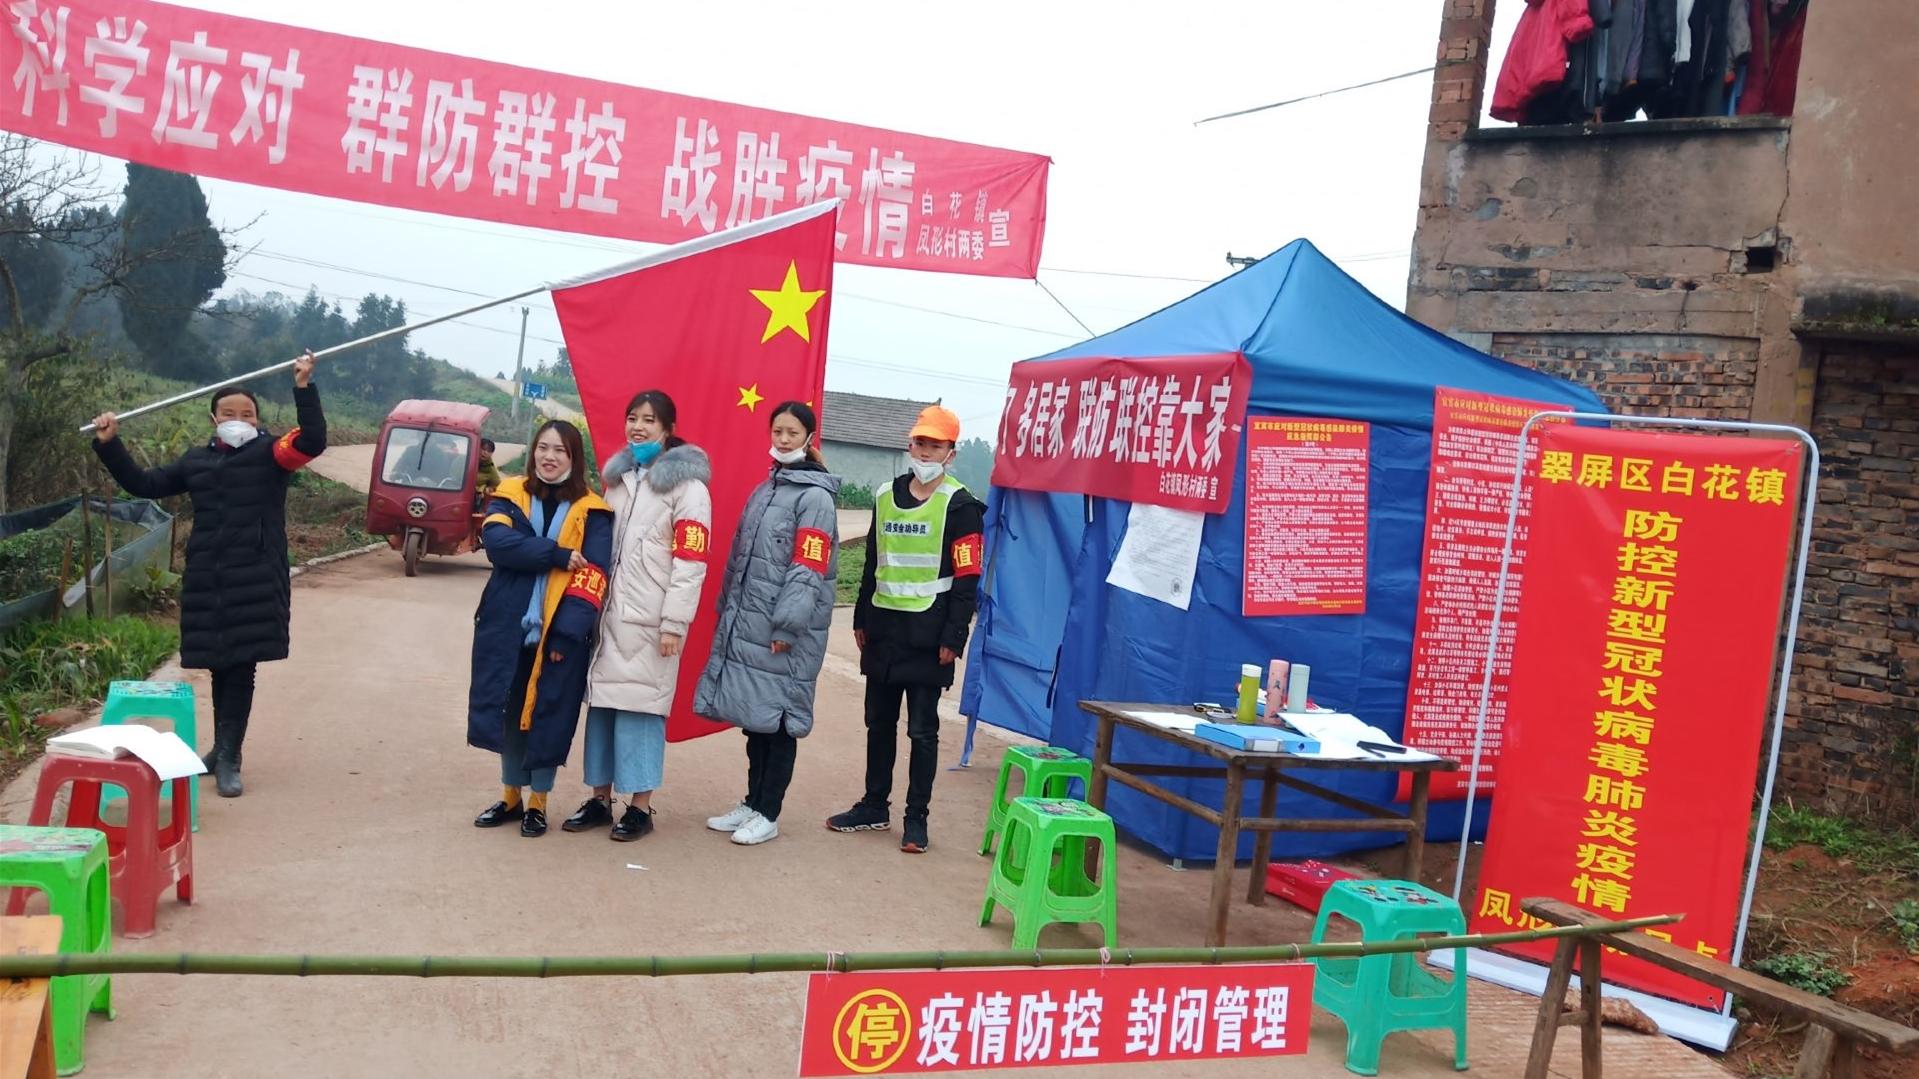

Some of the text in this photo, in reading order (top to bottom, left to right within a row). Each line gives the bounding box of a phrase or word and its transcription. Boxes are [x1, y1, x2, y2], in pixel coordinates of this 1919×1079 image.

[8, 0, 304, 164] 科学应对
[341, 65, 627, 215] 群防群控
[989, 208, 1010, 247] 宣
[1016, 378, 1071, 459] 多居家
[1072, 375, 1232, 472] 联防联控靠大家
[1209, 476, 1218, 500] 宣
[1539, 450, 1787, 506] 翠屏区白花镇
[1571, 509, 1683, 912] 防控新型冠状病毒肺炎疫情
[847, 986, 1290, 1066] 停 疫情防控 封闭管理
